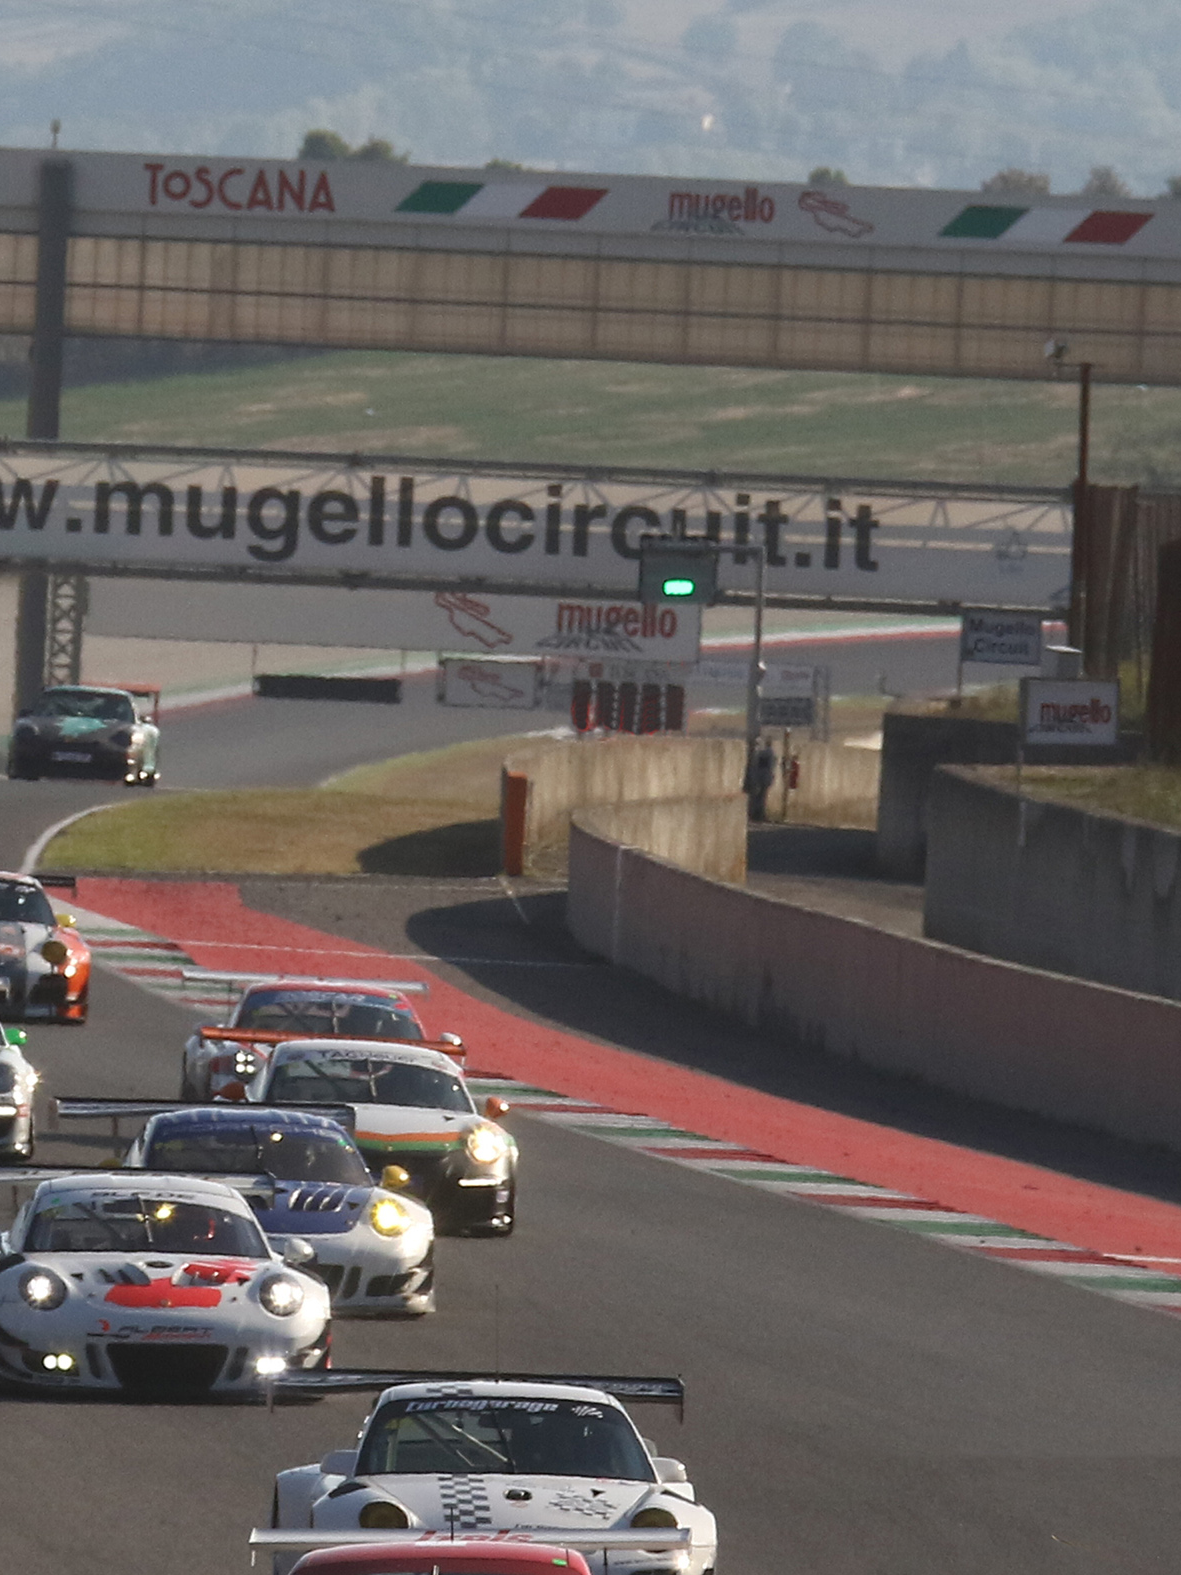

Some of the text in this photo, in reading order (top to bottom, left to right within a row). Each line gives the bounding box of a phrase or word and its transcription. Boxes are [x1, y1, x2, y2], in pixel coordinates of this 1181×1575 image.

[144, 163, 336, 213] TOSCANA
[669, 186, 775, 224] mugello
[557, 601, 678, 638] mugello
[1040, 697, 1112, 724] mugello
